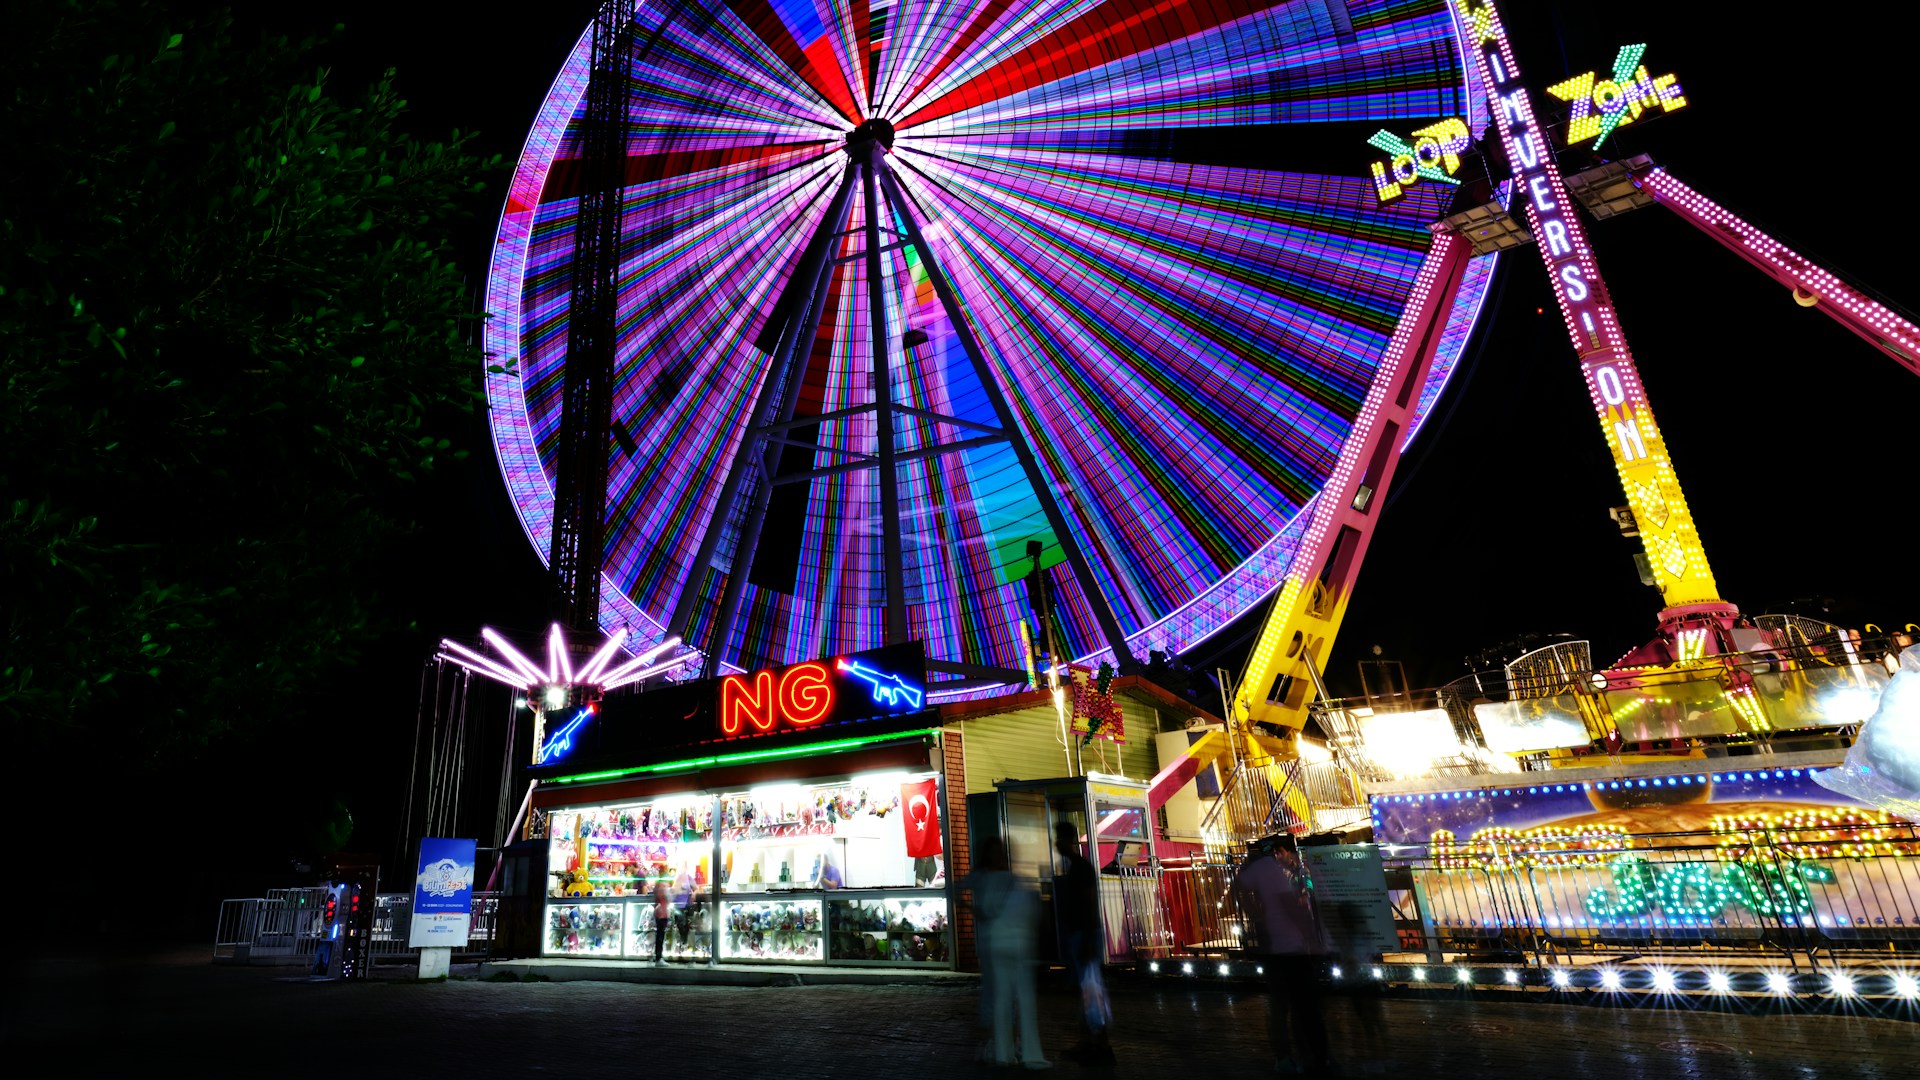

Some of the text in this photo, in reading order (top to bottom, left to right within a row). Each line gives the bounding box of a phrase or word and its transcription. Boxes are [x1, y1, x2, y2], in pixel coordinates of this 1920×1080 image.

[1546, 65, 1687, 145] ZONE
[1370, 118, 1470, 202] LOOP
[1490, 54, 1646, 461] INVERSION
[723, 665, 831, 732] NG
